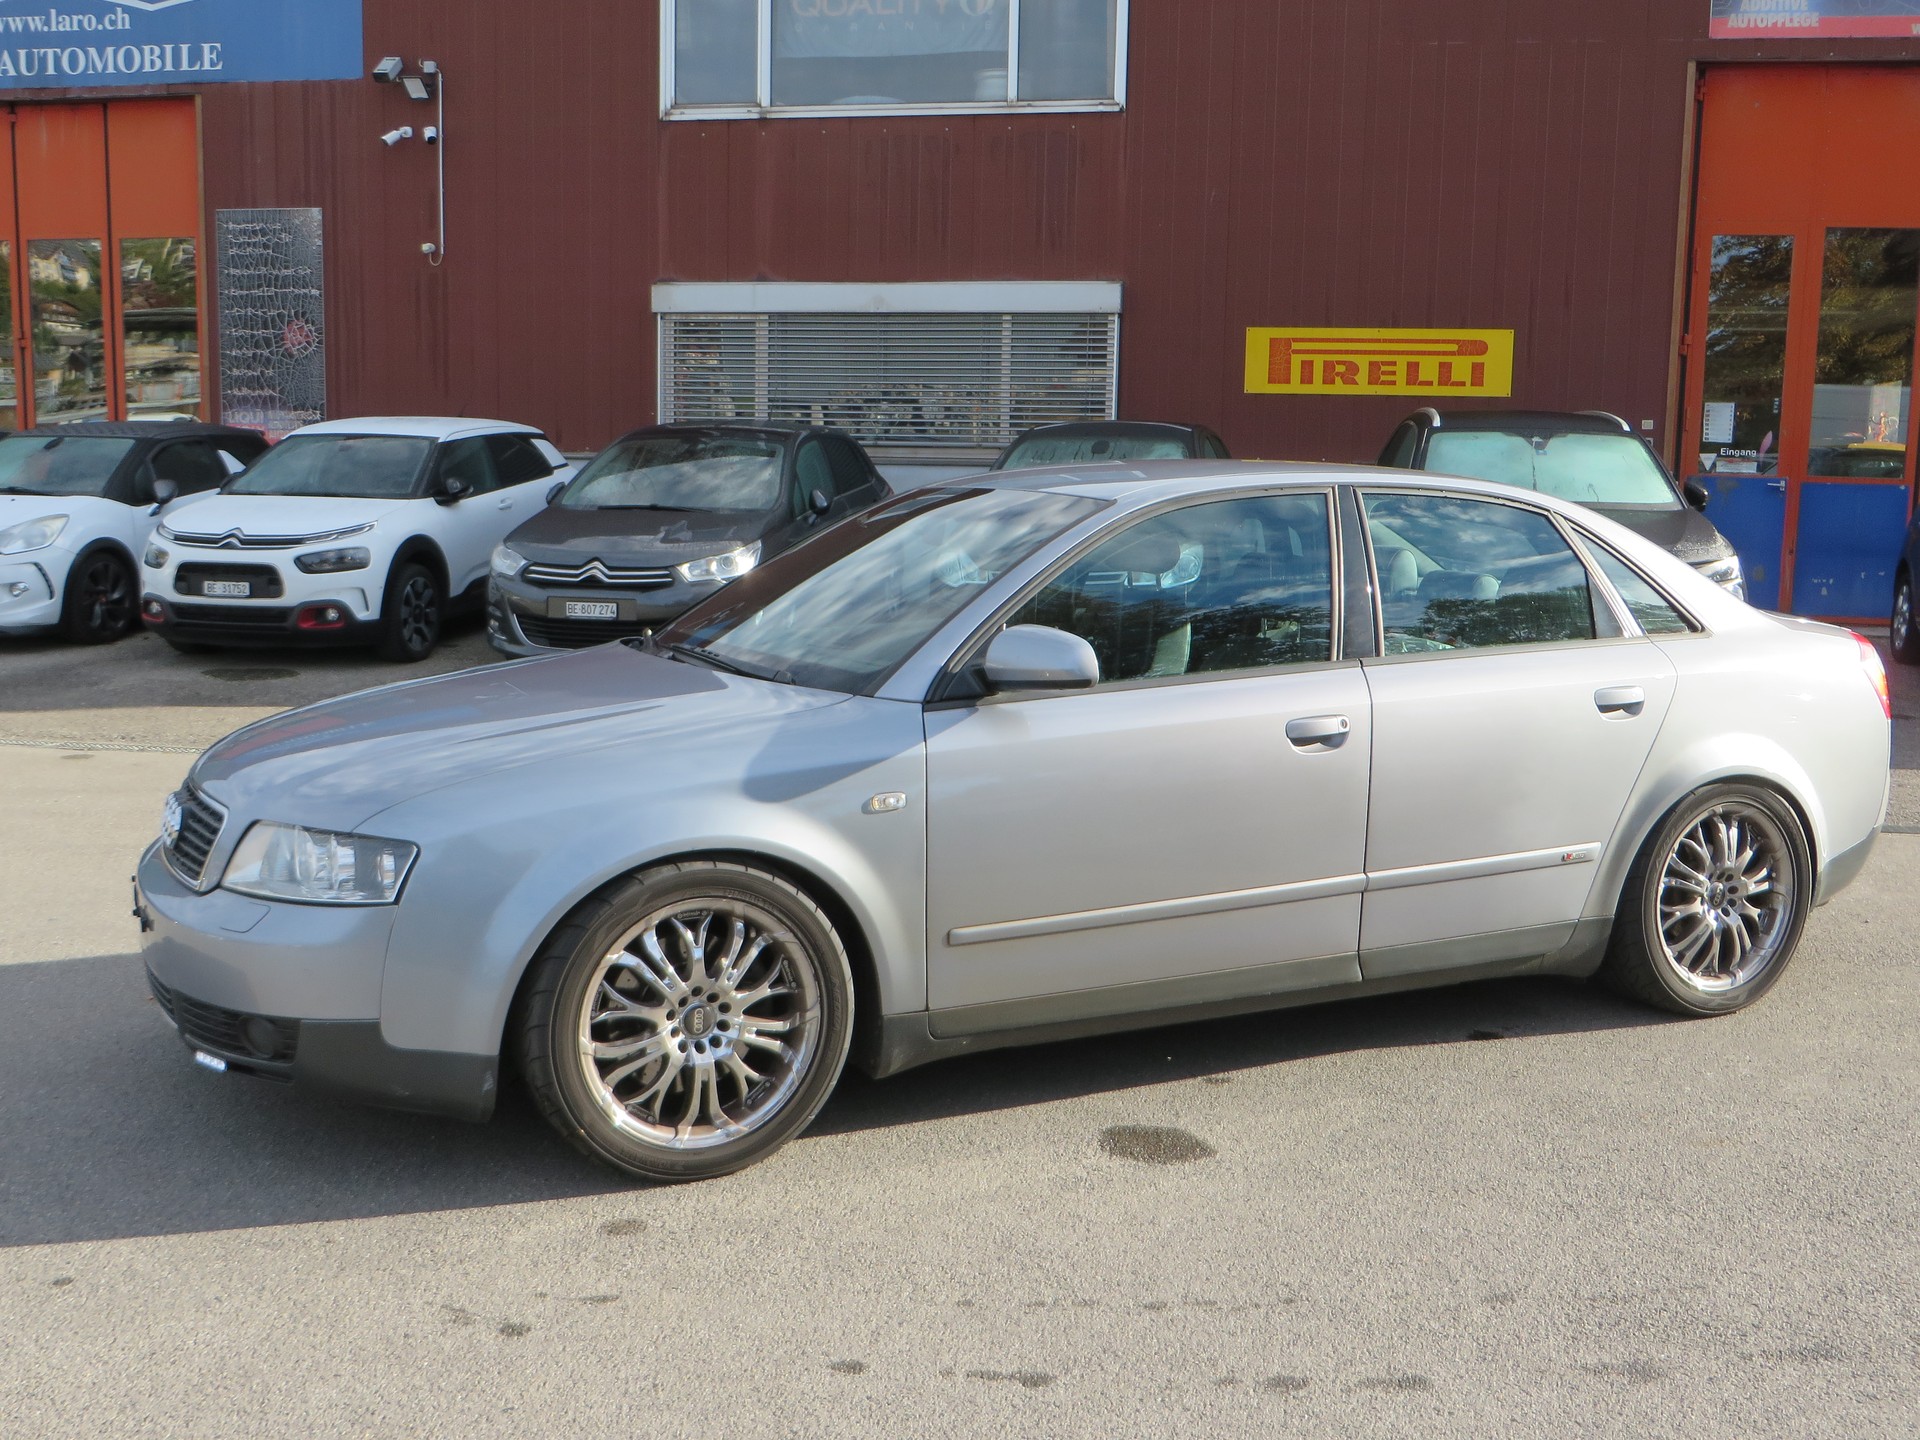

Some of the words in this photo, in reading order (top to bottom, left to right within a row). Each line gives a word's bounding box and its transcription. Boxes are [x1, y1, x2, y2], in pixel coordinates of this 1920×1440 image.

[1727, 12, 1820, 28] AUTOPFLEGE
[0, 43, 223, 76] AUTOMOBILE
[1268, 338, 1489, 387] PIRELLI
[1720, 447, 1757, 457] Eingang
